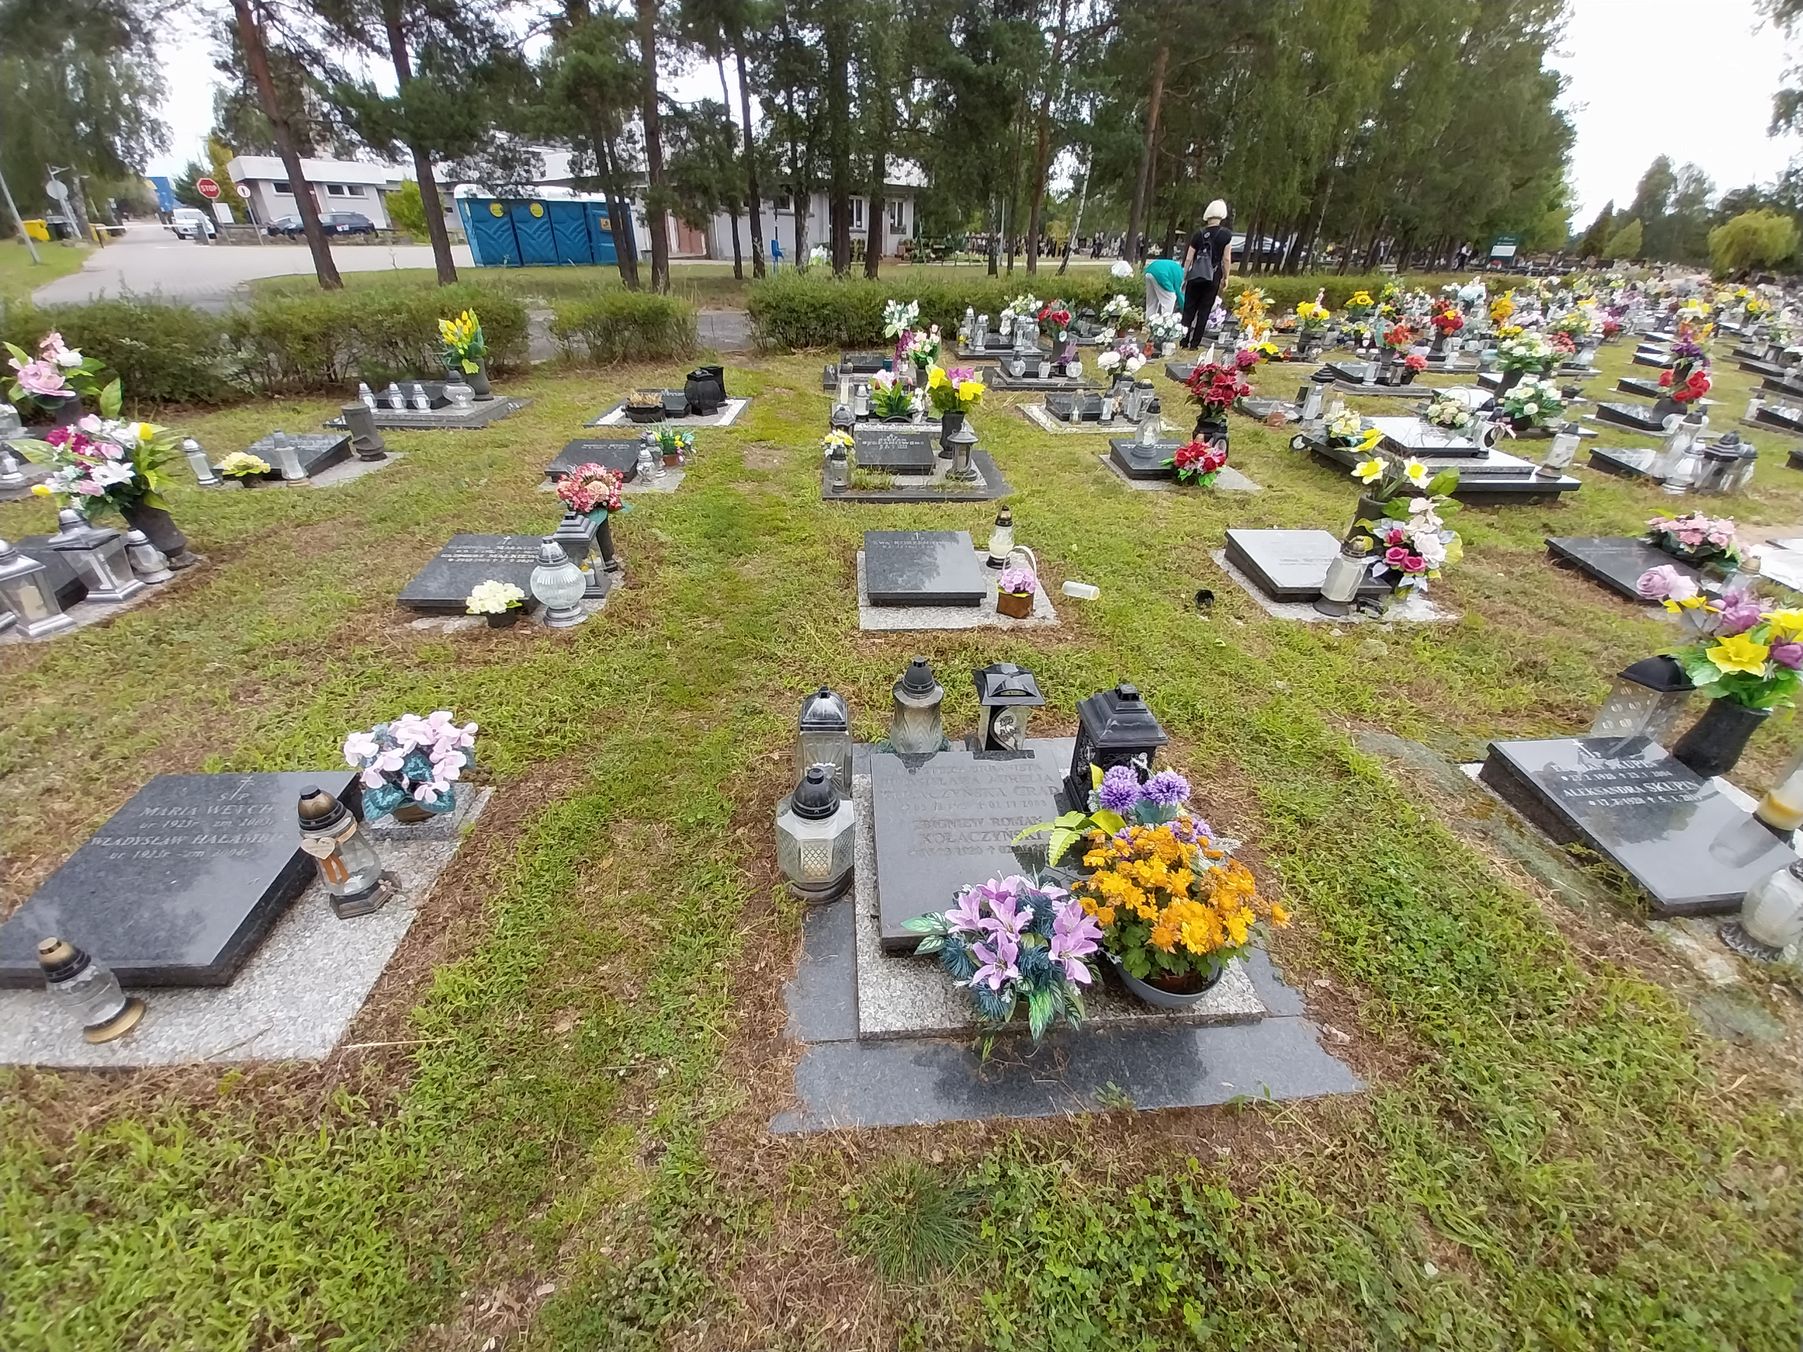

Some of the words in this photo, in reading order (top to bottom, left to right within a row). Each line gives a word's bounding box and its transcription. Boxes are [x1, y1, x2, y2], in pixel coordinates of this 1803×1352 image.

[200, 184, 218, 192] STOP
[1563, 784, 1647, 798] ALEKSANDRA
[140, 806, 199, 817] MARIA
[91, 835, 189, 846] WŁADYSŁAW
